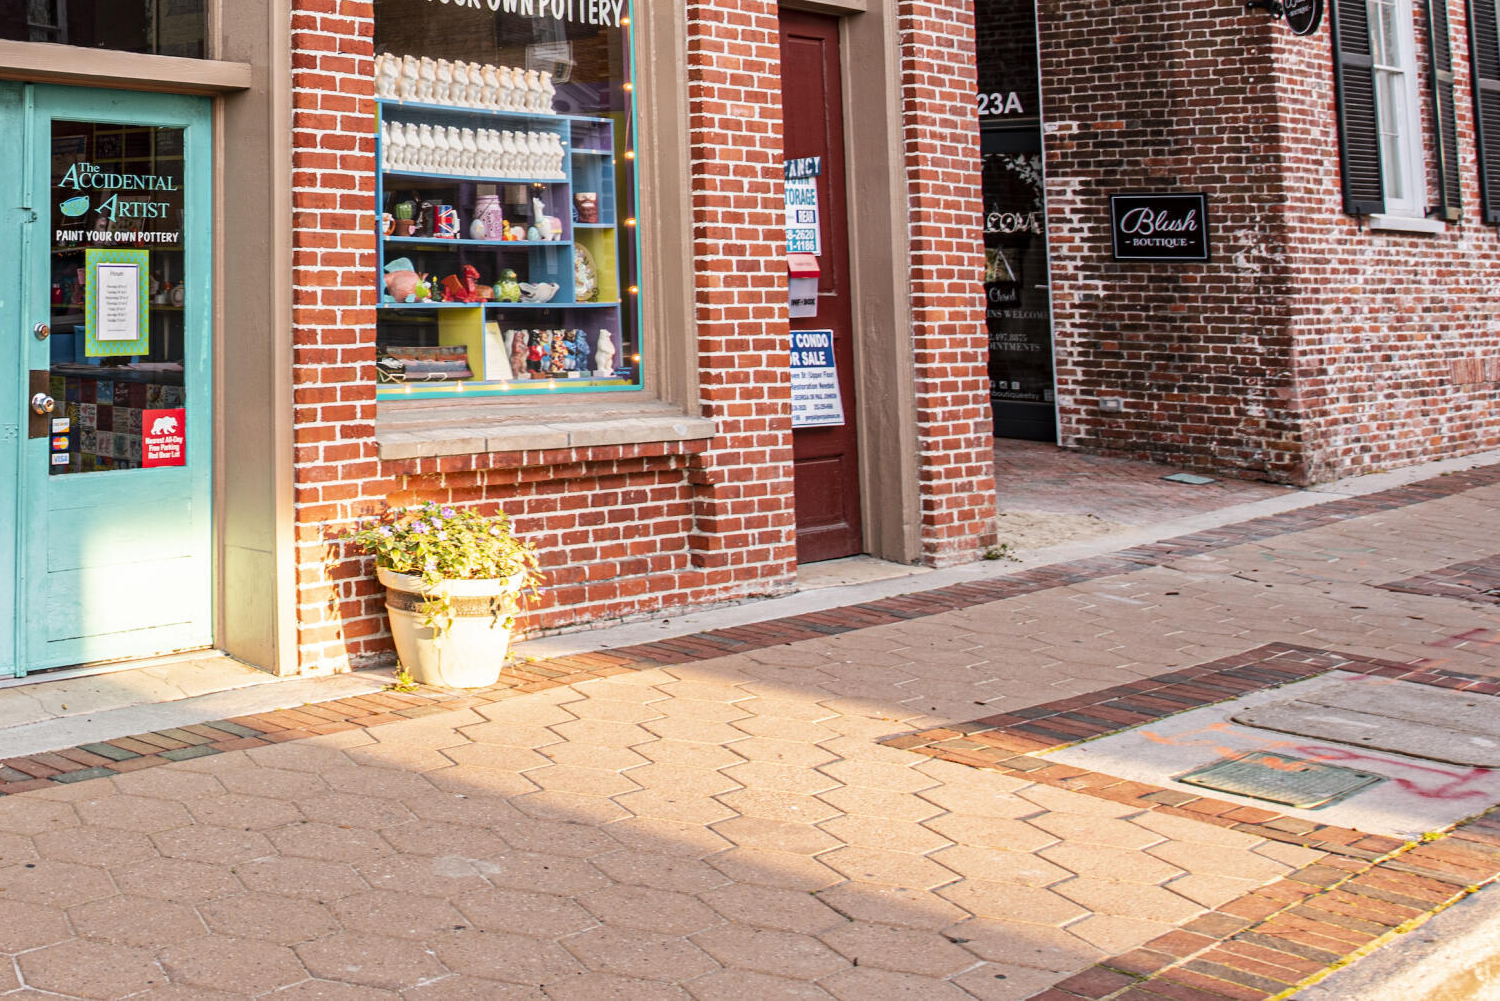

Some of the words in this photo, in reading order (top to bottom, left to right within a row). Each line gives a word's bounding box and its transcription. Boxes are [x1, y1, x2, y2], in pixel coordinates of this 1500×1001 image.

[78, 162, 100, 172] The
[784, 157, 820, 177] ANCY
[57, 163, 178, 191] ACCIDENTAL
[785, 189, 816, 205] TORAGE
[94, 193, 170, 222] ARTIST
[1120, 207, 1198, 235] Blush
[56, 230, 84, 241] PAINT
[86, 230, 112, 242] YOUR
[114, 231, 136, 242] OWN
[138, 231, 179, 243] POTTERY
[1133, 238, 1188, 248] BOUTIQUE
[796, 333, 829, 348] CONDO
[801, 351, 827, 365] SALE
